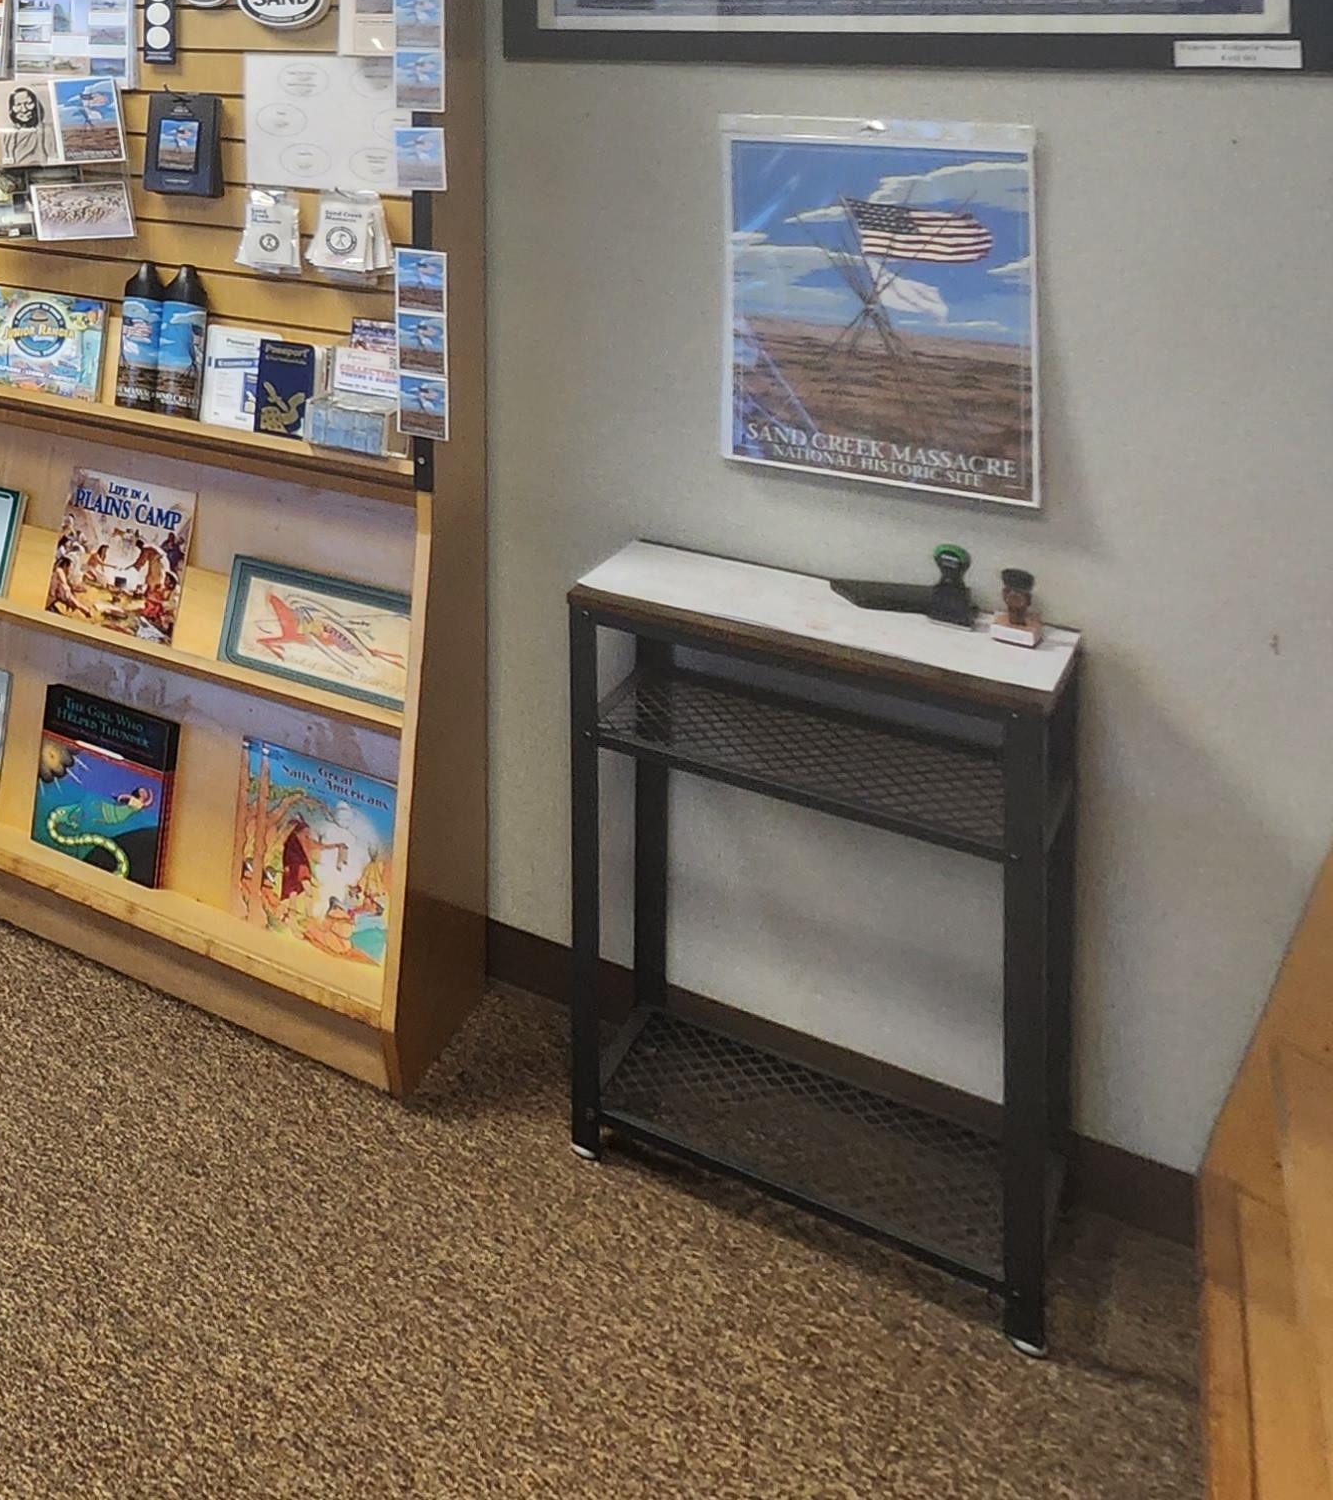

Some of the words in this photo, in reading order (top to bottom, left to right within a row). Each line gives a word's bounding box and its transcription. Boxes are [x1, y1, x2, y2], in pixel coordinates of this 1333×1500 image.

[2, 325, 36, 340] JUNIOR
[38, 323, 75, 339] RANGER
[747, 422, 808, 446] SAND
[811, 431, 885, 458] CREEK
[887, 443, 1018, 479] MASSACRE
[772, 445, 859, 469] NATIONAL
[860, 457, 942, 483] HISTORIC
[946, 470, 983, 488] SITE
[74, 488, 132, 520] PLAINS
[135, 504, 183, 531] CAMP
[108, 482, 129, 497] LIFE
[131, 488, 142, 500] IN
[143, 492, 150, 502] A
[56, 707, 98, 729] HELPED
[99, 720, 150, 748] THUNDER
[64, 695, 83, 712] THE
[87, 704, 112, 721] GIRL
[116, 713, 144, 733] WHO
[281, 764, 318, 785] Native
[324, 779, 389, 811] Americans
[318, 766, 353, 786] Great
